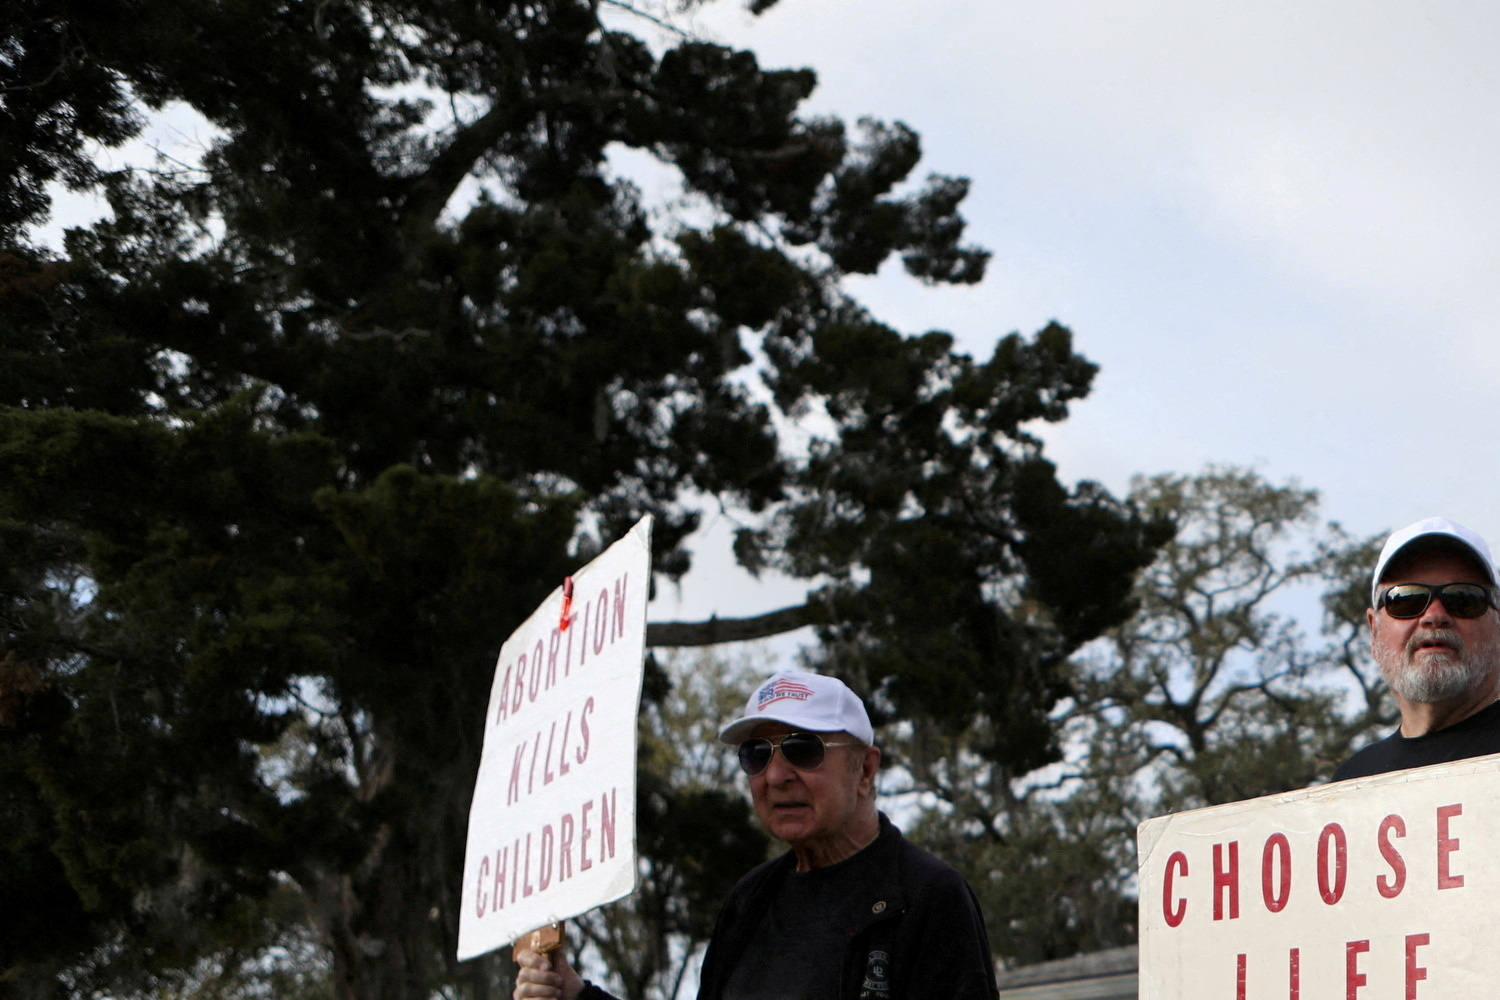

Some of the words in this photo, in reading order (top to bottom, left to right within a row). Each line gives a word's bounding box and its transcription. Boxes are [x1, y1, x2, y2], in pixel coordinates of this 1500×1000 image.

[497, 572, 627, 725] ABORTION
[508, 696, 594, 806] KILLS
[476, 787, 616, 918] CHILDREN
[1162, 803, 1464, 928] CHOOSE
